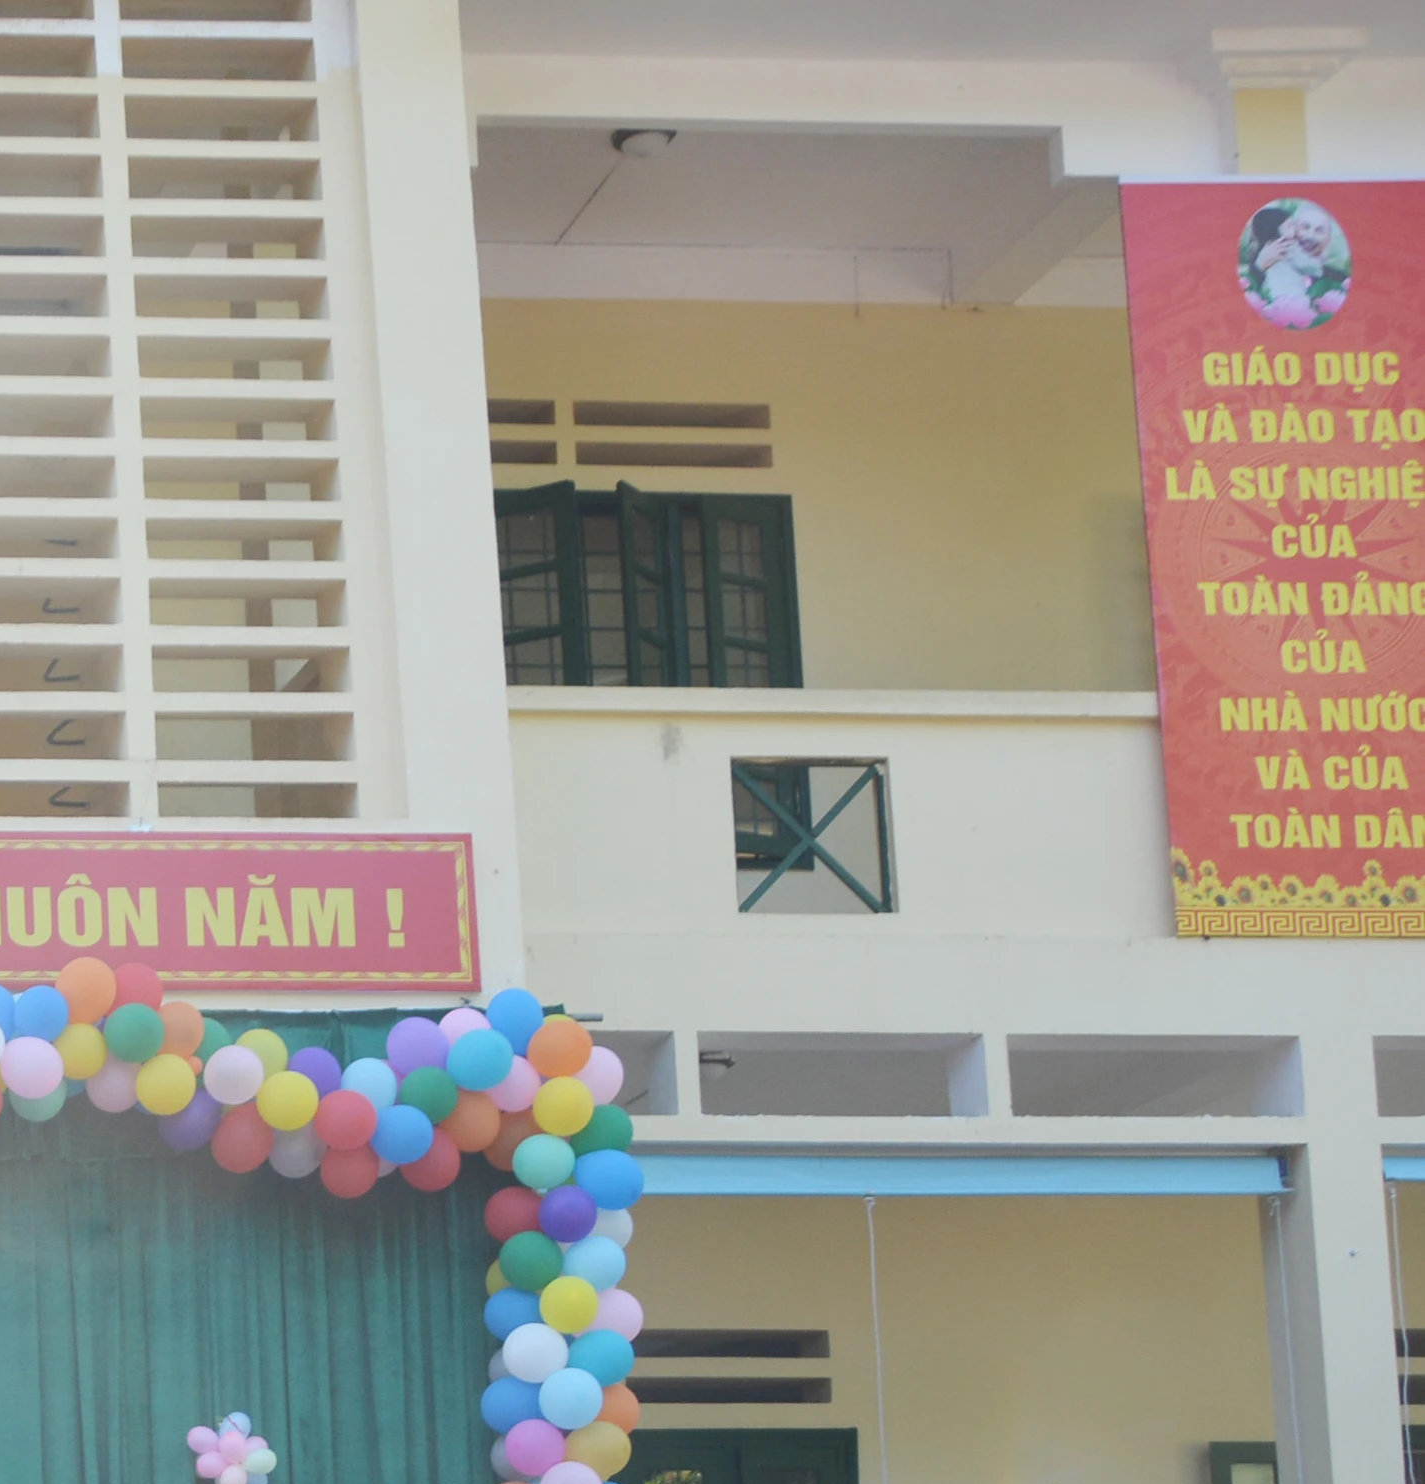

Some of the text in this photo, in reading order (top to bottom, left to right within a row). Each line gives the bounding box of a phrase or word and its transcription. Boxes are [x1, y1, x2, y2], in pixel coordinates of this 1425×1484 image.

[1204, 346, 1399, 392] GIÁO DỤC
[1183, 403, 1425, 449] VÀ ĐÀO TẠO
[1166, 460, 1425, 507] LÀ SỰ NGHIỆ
[1273, 514, 1356, 557] CỦA
[1198, 576, 1309, 615] TOÀN
[1282, 630, 1366, 673] CỦA
[1221, 691, 1308, 731] NHÀ
[1256, 745, 1408, 789] VÀ CỦA
[1231, 808, 1341, 848] TOÀN
[186, 875, 355, 946] NĂM
[387, 889, 405, 947] !
